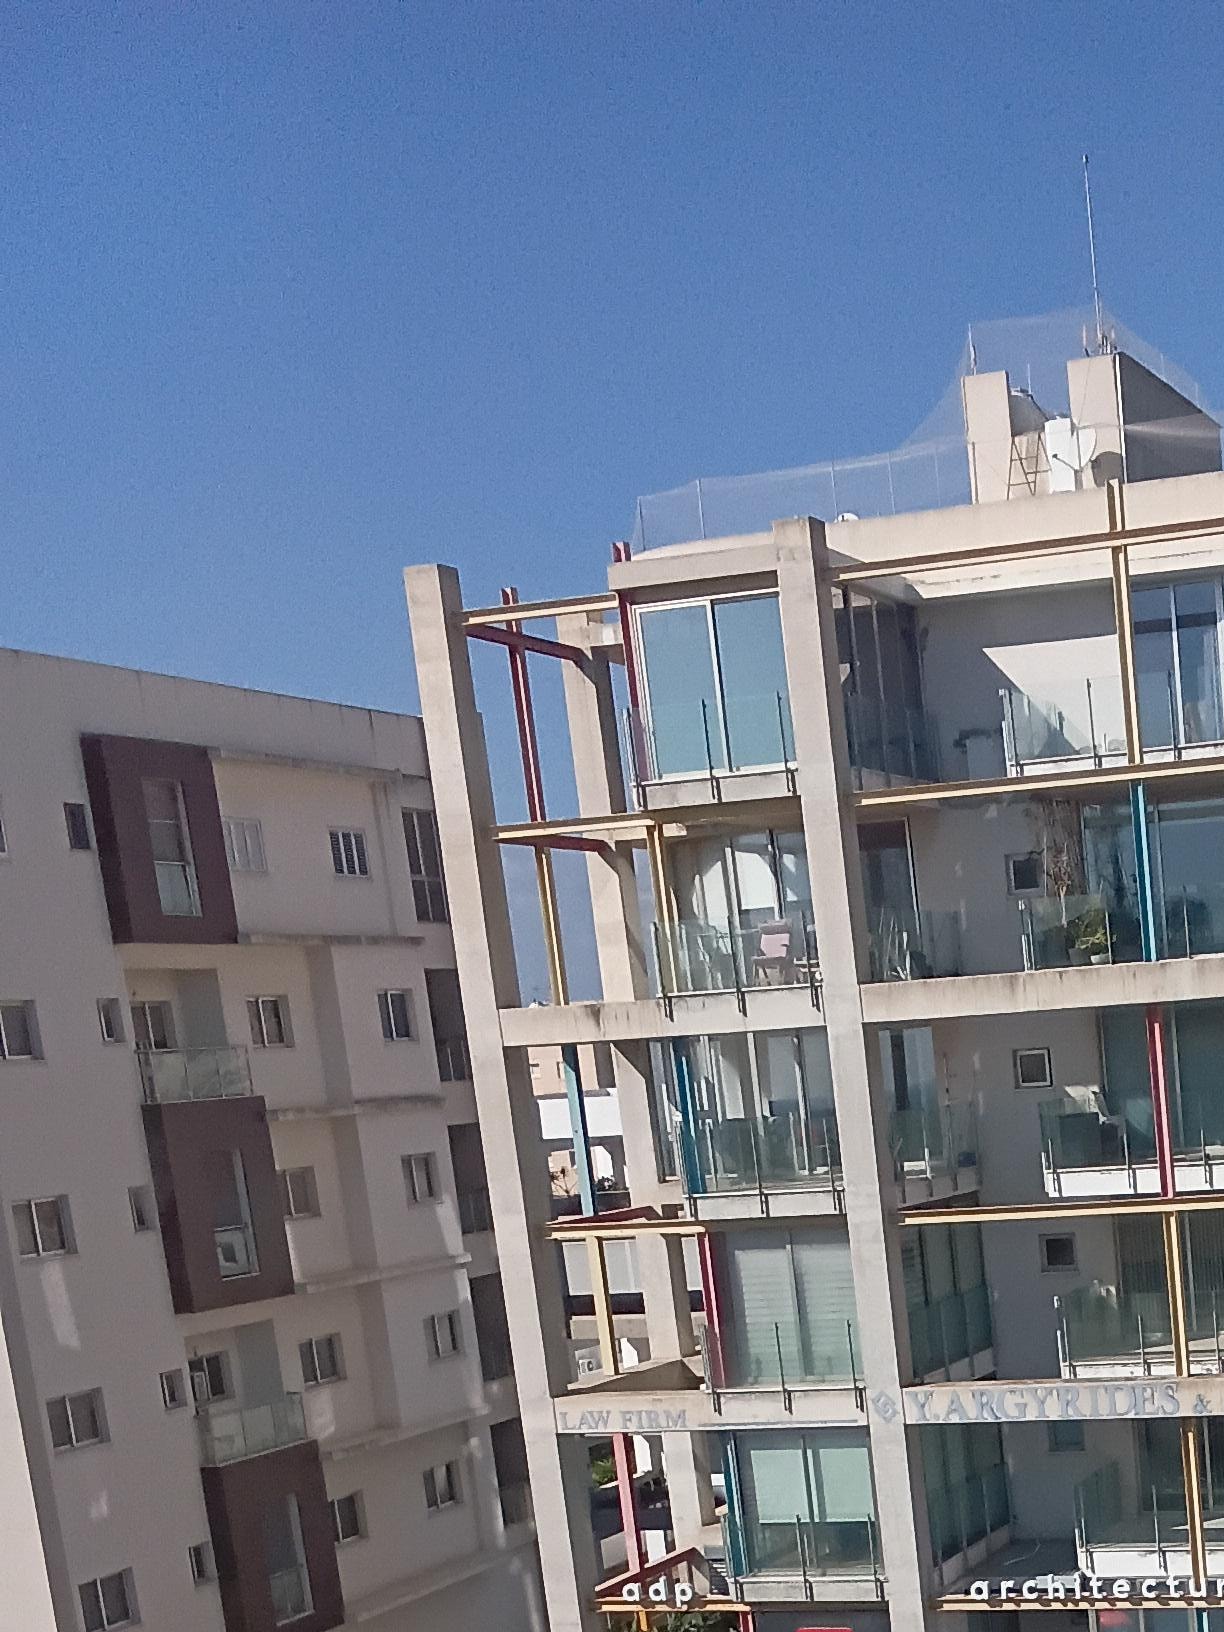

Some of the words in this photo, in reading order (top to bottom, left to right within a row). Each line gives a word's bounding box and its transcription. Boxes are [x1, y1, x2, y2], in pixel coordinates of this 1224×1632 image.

[1192, 1393, 1212, 1414] &
[559, 1410, 611, 1430] LAW
[619, 1409, 689, 1430] FIRM
[622, 1574, 694, 1608] adp
